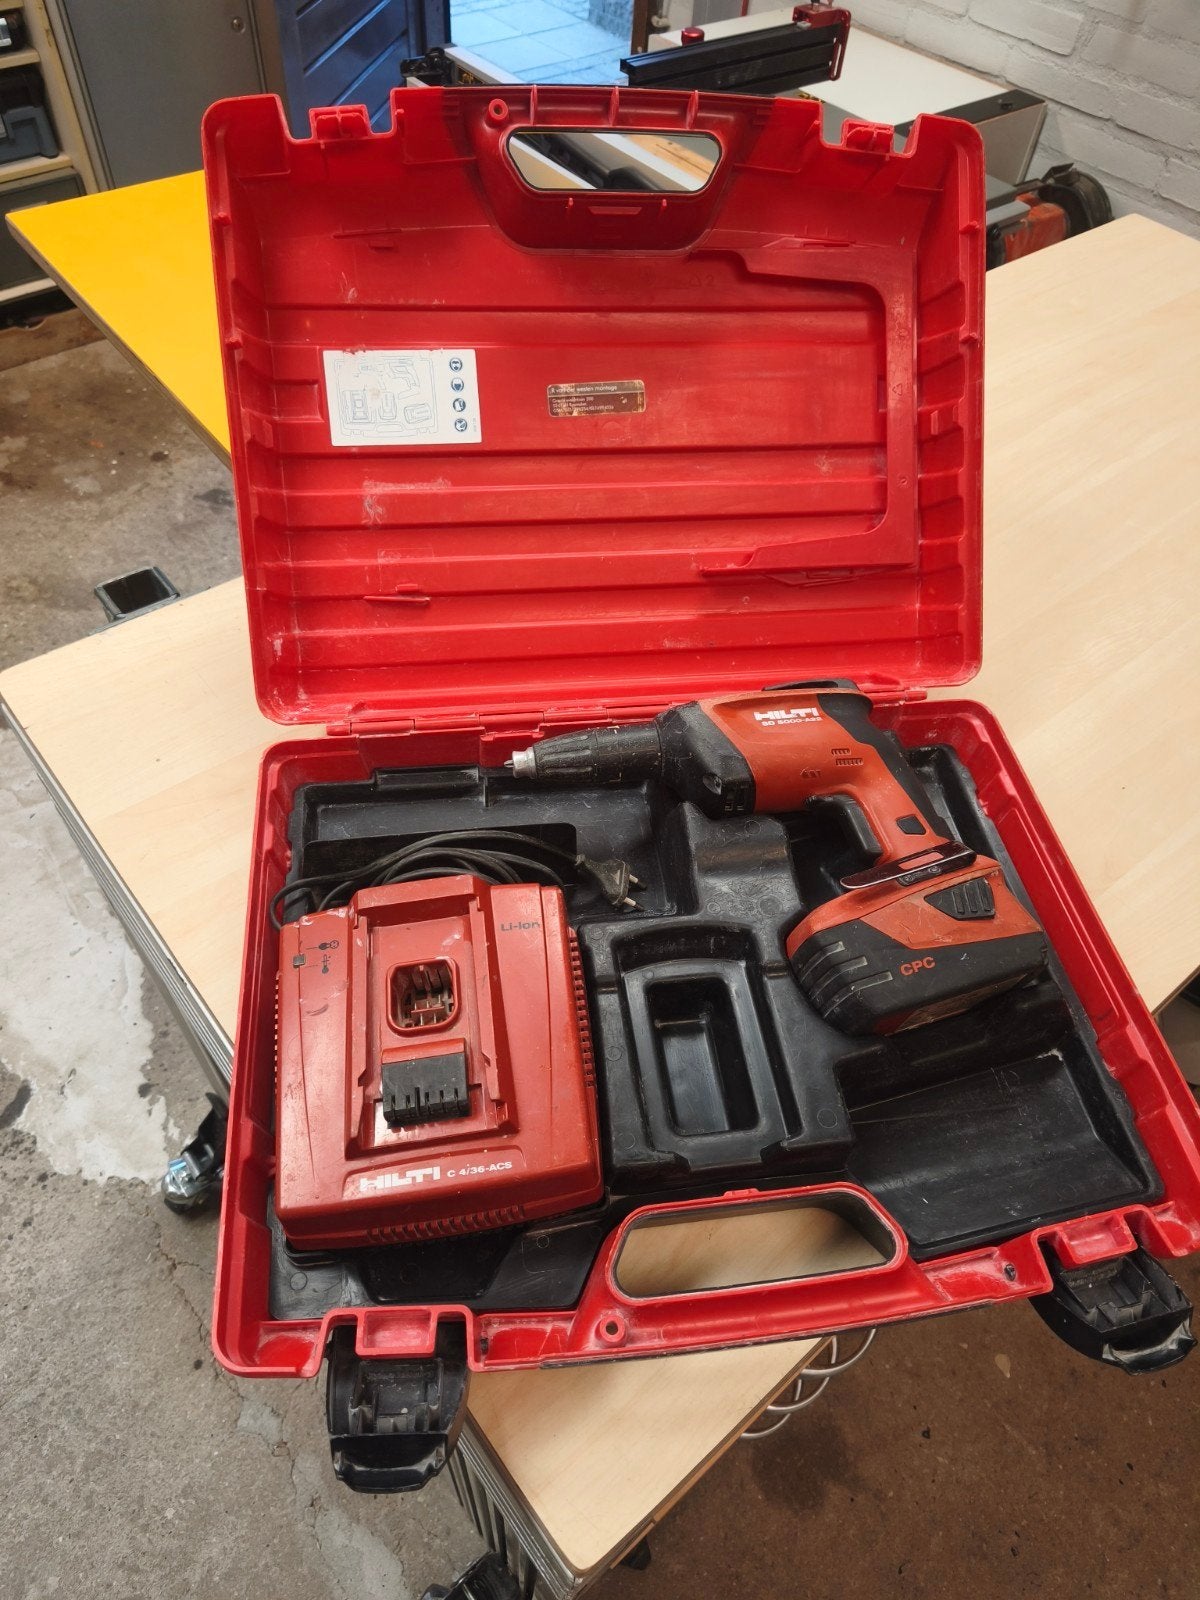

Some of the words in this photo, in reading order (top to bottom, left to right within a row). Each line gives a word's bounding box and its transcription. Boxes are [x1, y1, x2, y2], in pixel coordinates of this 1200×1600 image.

[753, 708, 819, 720] HILTI
[500, 921, 541, 931] Li-Ion
[900, 957, 935, 975] CPC
[360, 1166, 441, 1192] HILTI
[447, 1169, 456, 1178] C
[459, 1161, 513, 1177] 4/36-ACS
